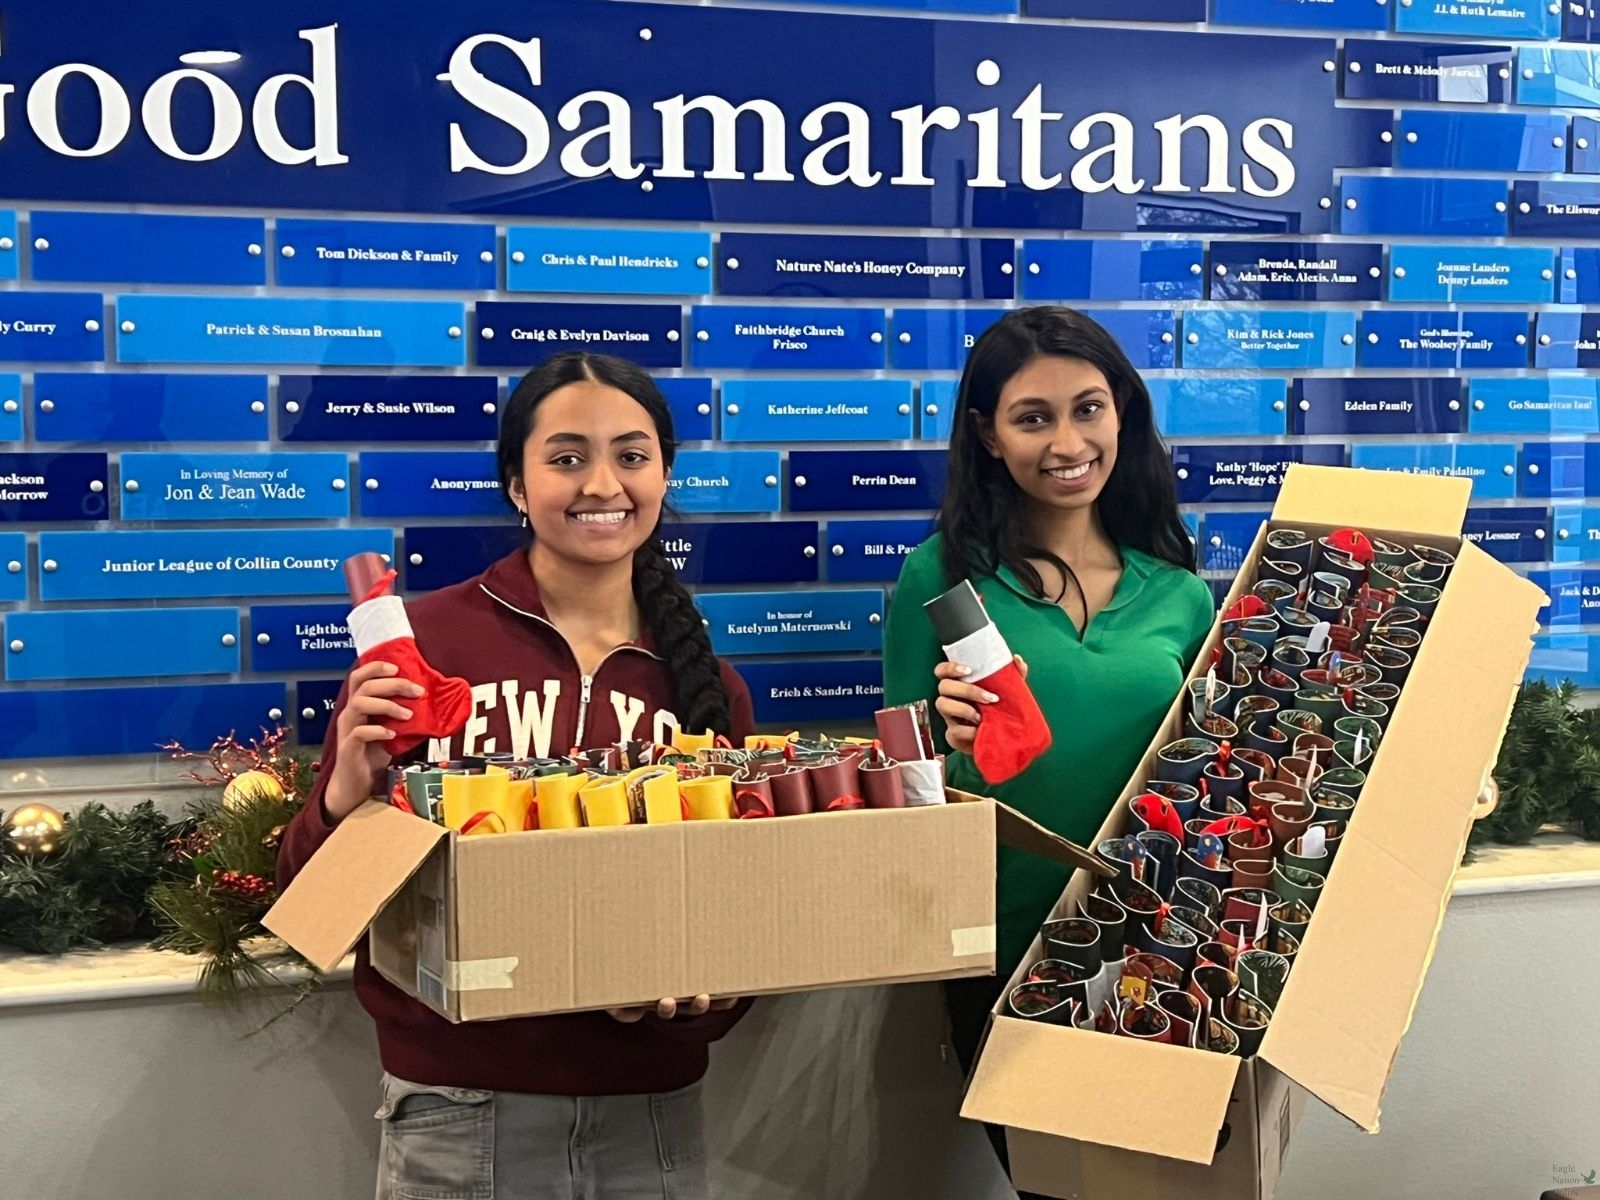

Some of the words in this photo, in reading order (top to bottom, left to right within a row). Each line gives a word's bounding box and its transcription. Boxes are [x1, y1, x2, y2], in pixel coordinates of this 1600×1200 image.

[1450, 5, 1458, 15] &
[1460, 6, 1485, 16] Ruth
[1487, 7, 1526, 18] Lemaire
[1376, 64, 1401, 74] Brett
[1403, 65, 1412, 75] &
[1414, 65, 1449, 79] Melody
[0, 22, 349, 166] ood
[446, 33, 1296, 199] Samaritans
[1546, 205, 1564, 214] The
[316, 247, 344, 260] Tom
[347, 248, 398, 261] Dickson
[401, 251, 412, 262] &
[415, 251, 459, 264] Family
[541, 254, 574, 265] Chris
[577, 256, 588, 267] &
[591, 256, 616, 267] Paul
[619, 256, 679, 269] Hendricks
[776, 260, 820, 274] Nature
[823, 261, 861, 275] Nate's
[863, 262, 903, 277] Honey
[906, 263, 966, 279] Company
[1258, 258, 1297, 269] Brenda,
[1298, 260, 1337, 270] Randall
[1436, 262, 1470, 272] Joanne
[1472, 262, 1510, 272] Landers
[1330, 273, 1357, 282] Anna
[1438, 274, 1469, 286] Denny
[1470, 276, 1508, 285] Landers
[13, 321, 56, 335] Curry
[206, 324, 255, 336] Patrick
[258, 325, 269, 337] &
[272, 325, 310, 337] Susan
[313, 325, 381, 338] Brosnahan
[735, 325, 800, 339] Faithbridge
[803, 325, 844, 337] Church
[1228, 329, 1248, 338] Kim
[1250, 329, 1258, 338] &
[1262, 329, 1284, 338] Rick
[1286, 330, 1314, 338] Jones
[511, 328, 545, 343] Craig
[547, 330, 558, 342] &
[560, 330, 600, 345] Evelyn
[603, 330, 649, 342] Davison
[773, 339, 808, 350] Frisco
[1241, 342, 1265, 350] Better
[1266, 342, 1299, 350] Together
[1400, 339, 1418, 348] The
[1420, 339, 1458, 351] Woolsey
[1460, 340, 1493, 351] Family
[326, 401, 360, 415] Jerry
[363, 402, 374, 413] &
[376, 402, 410, 414] Susie
[412, 402, 455, 414] Wilson
[768, 404, 823, 415] Katherine
[825, 404, 868, 415] Jeffcoat
[1344, 401, 1378, 410] Edelen
[1379, 401, 1413, 412] Family
[1508, 400, 1522, 410] Go
[1524, 400, 1572, 410] Samaritan
[1216, 462, 1246, 474] Kathy
[1444, 466, 1486, 476] Padalino
[180, 470, 191, 480] In
[194, 470, 229, 482] Loving
[233, 469, 275, 481] Memory
[277, 468, 288, 479] of
[852, 474, 886, 486] Perrin
[889, 474, 916, 485] Dean
[1236, 475, 1266, 486] Peggy
[1268, 475, 1276, 484] &
[430, 478, 503, 491] Anonymou
[686, 476, 729, 487] Church
[164, 484, 191, 501] Jon
[198, 484, 212, 500] &
[218, 484, 255, 501] Jean
[260, 484, 305, 499] Wade
[1486, 531, 1520, 540] Lessner
[864, 545, 883, 554] Bill
[886, 545, 895, 554] &
[102, 559, 154, 572] Junior
[158, 558, 212, 575] League
[216, 557, 232, 570] of
[234, 556, 281, 569] Collin
[284, 556, 339, 573] County
[1560, 587, 1580, 596] Jack
[1582, 587, 1590, 595] &
[767, 612, 776, 620] In
[728, 624, 778, 635] Katelynn
[780, 620, 851, 632] Maternowski
[771, 688, 800, 698] Erich
[803, 687, 812, 696] &
[815, 686, 853, 696] Sandra
